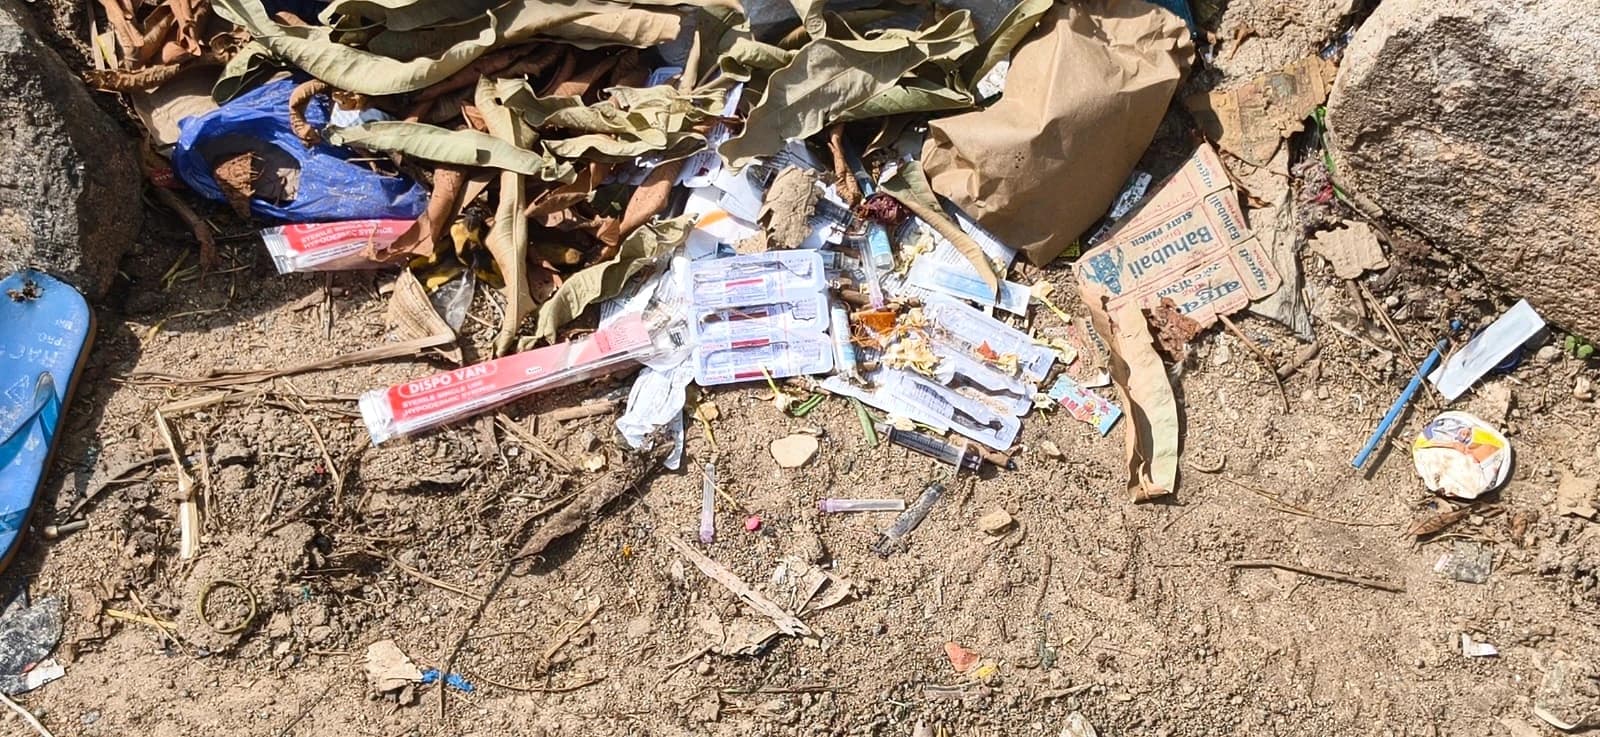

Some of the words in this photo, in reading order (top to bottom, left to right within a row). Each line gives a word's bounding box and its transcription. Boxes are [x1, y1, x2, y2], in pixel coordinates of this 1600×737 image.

[1164, 210, 1193, 230] SLATE
[1207, 194, 1240, 241] Bahubali
[1126, 225, 1213, 279] Bahubali
[1130, 226, 1163, 248] PENCIL
[1179, 279, 1241, 316] बाहुब
[407, 373, 452, 394] DISPO
[454, 364, 486, 381] VAN
